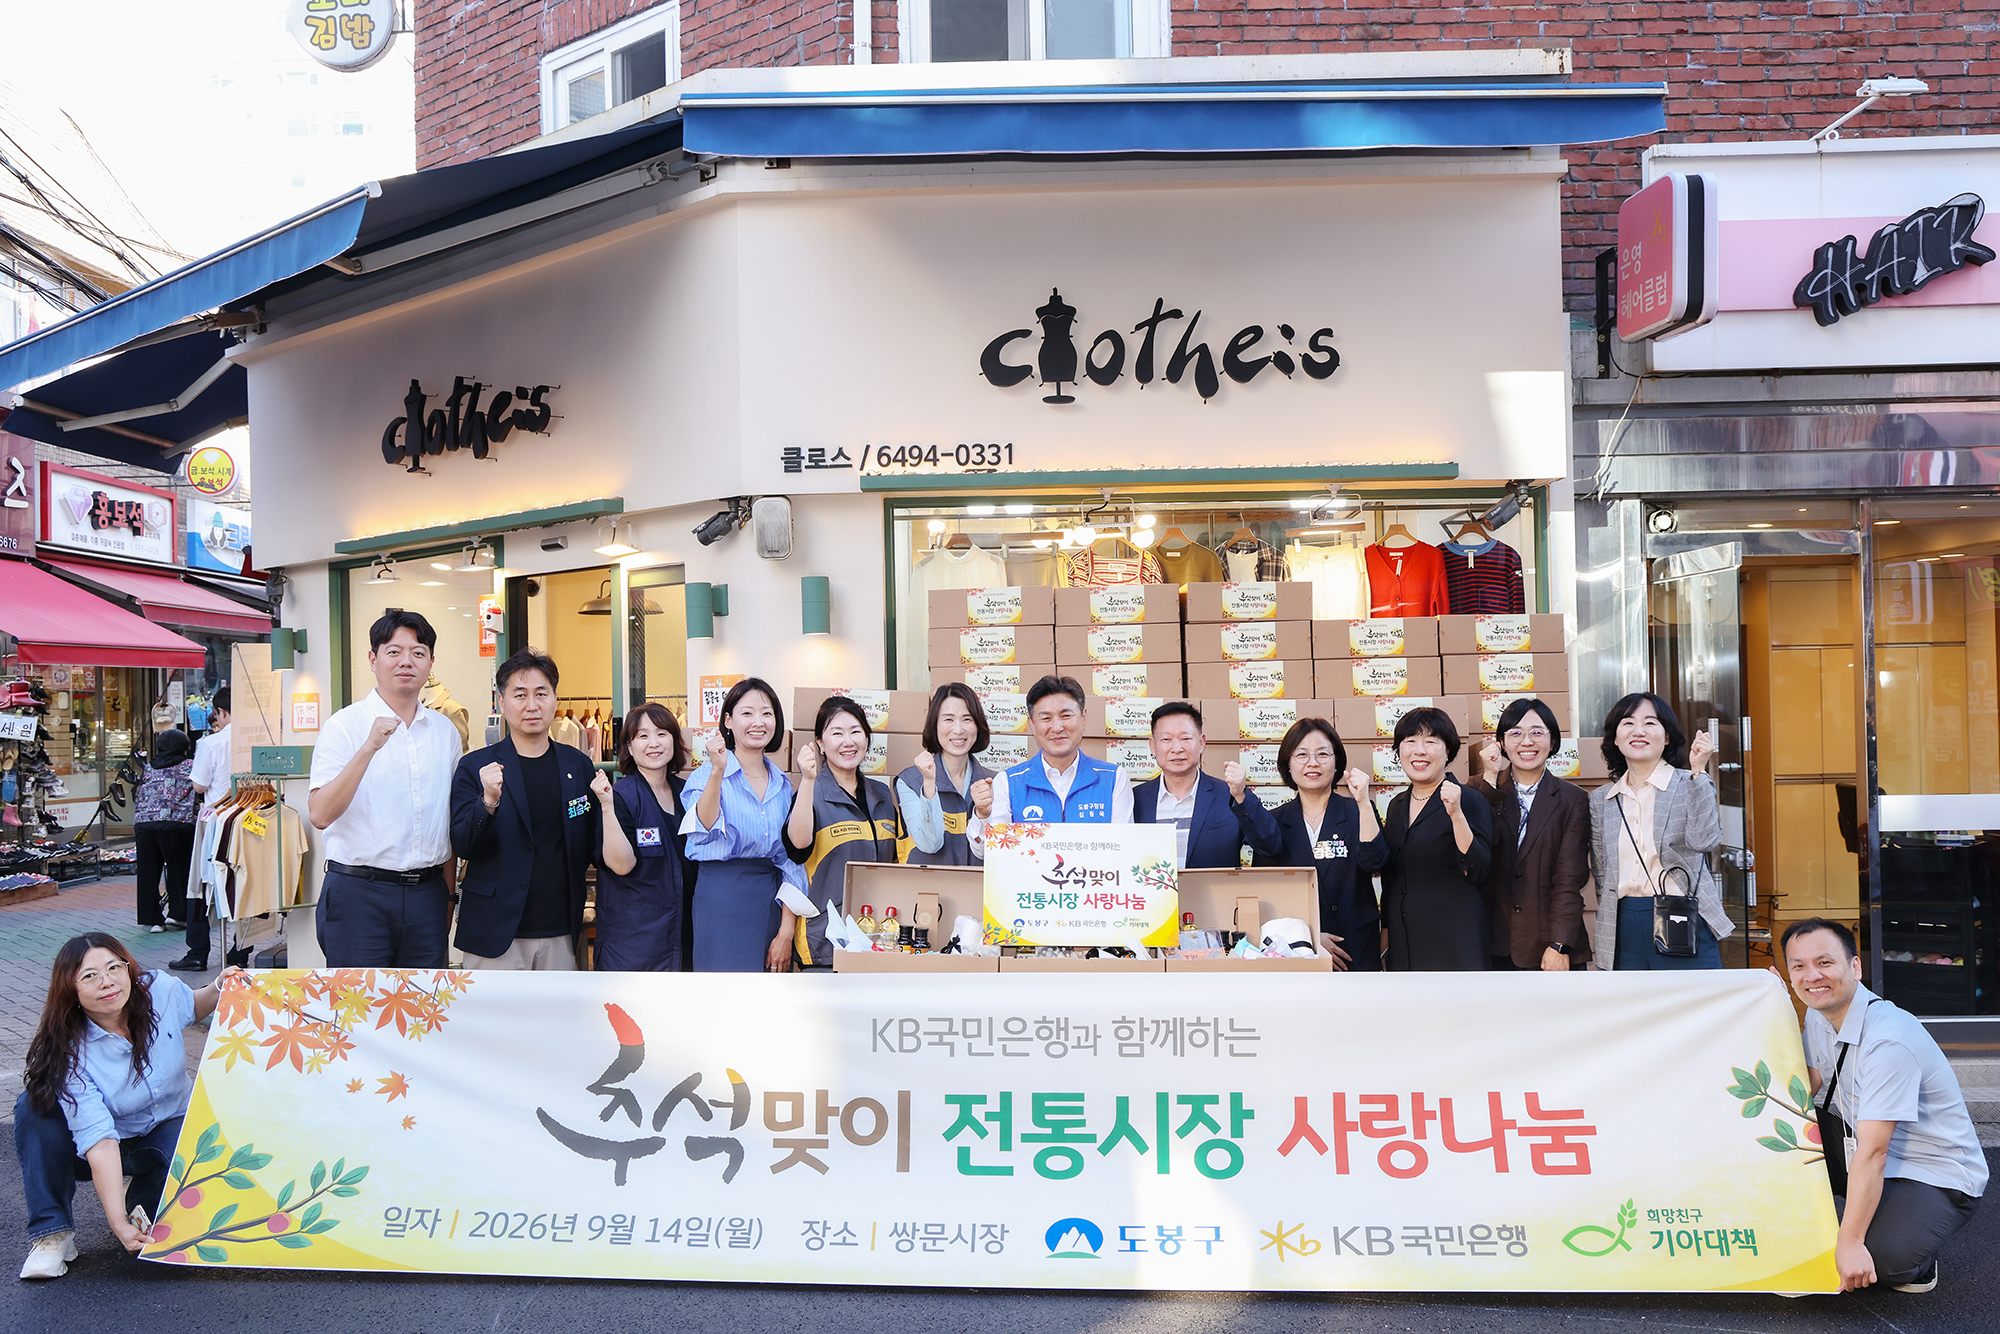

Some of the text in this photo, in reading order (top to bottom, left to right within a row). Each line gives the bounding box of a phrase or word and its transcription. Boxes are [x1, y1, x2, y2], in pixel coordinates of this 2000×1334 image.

[304, 13, 375, 51] 김밥
[1620, 240, 1642, 281] 은영
[1801, 192, 1996, 324] HAIR
[1621, 270, 1667, 319] 헤어클럽
[781, 445, 852, 473] 클로스
[876, 442, 1014, 468] 6494-0331
[95, 492, 144, 537] 홍보석
[1041, 842, 1121, 851] KB국민은행과 함께하는
[1041, 853, 1120, 889] 추석맞이
[1016, 892, 1146, 910] 전통시장 사랑나눔
[1027, 919, 1048, 927] 도봉구
[872, 1015, 1260, 1058] KB국민은행과 함께하는
[536, 1002, 909, 1187] 추석맞이
[943, 1090, 1597, 1179] 전통시장 사랑나눔
[382, 1207, 764, 1252] 일자 2026년 9월 14일(월)
[1646, 1207, 1703, 1223] 희망친구
[801, 1220, 1009, 1255] 장소 쌍문시장
[1117, 1223, 1224, 1256] 도봉구
[1650, 1229, 1758, 1257] 기아대책
